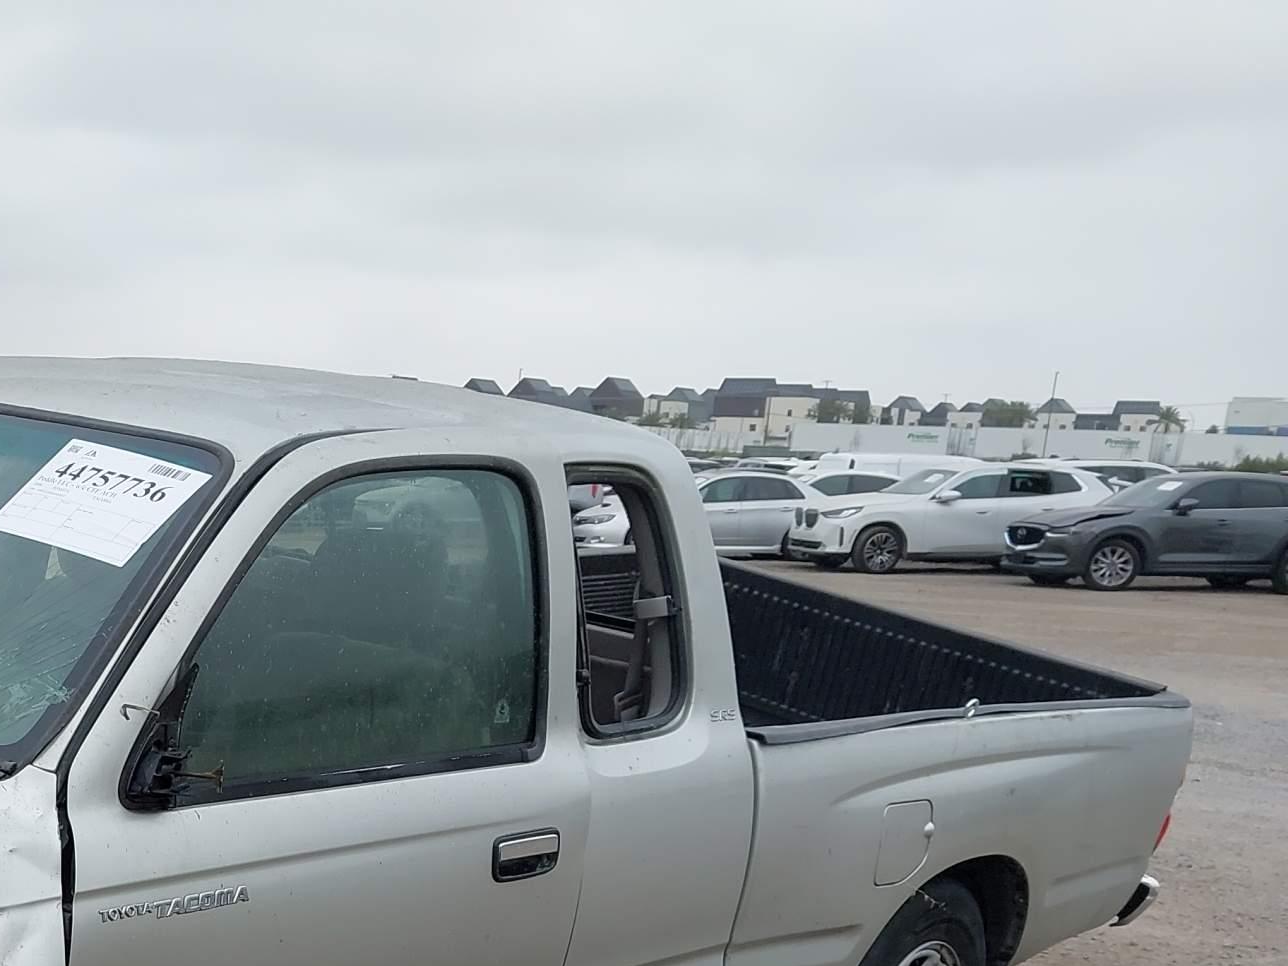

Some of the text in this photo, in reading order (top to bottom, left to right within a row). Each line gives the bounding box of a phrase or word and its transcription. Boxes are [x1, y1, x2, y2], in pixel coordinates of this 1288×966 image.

[54, 461, 174, 503] 44757736
[98, 885, 250, 924] TOYOTA TACOMA
